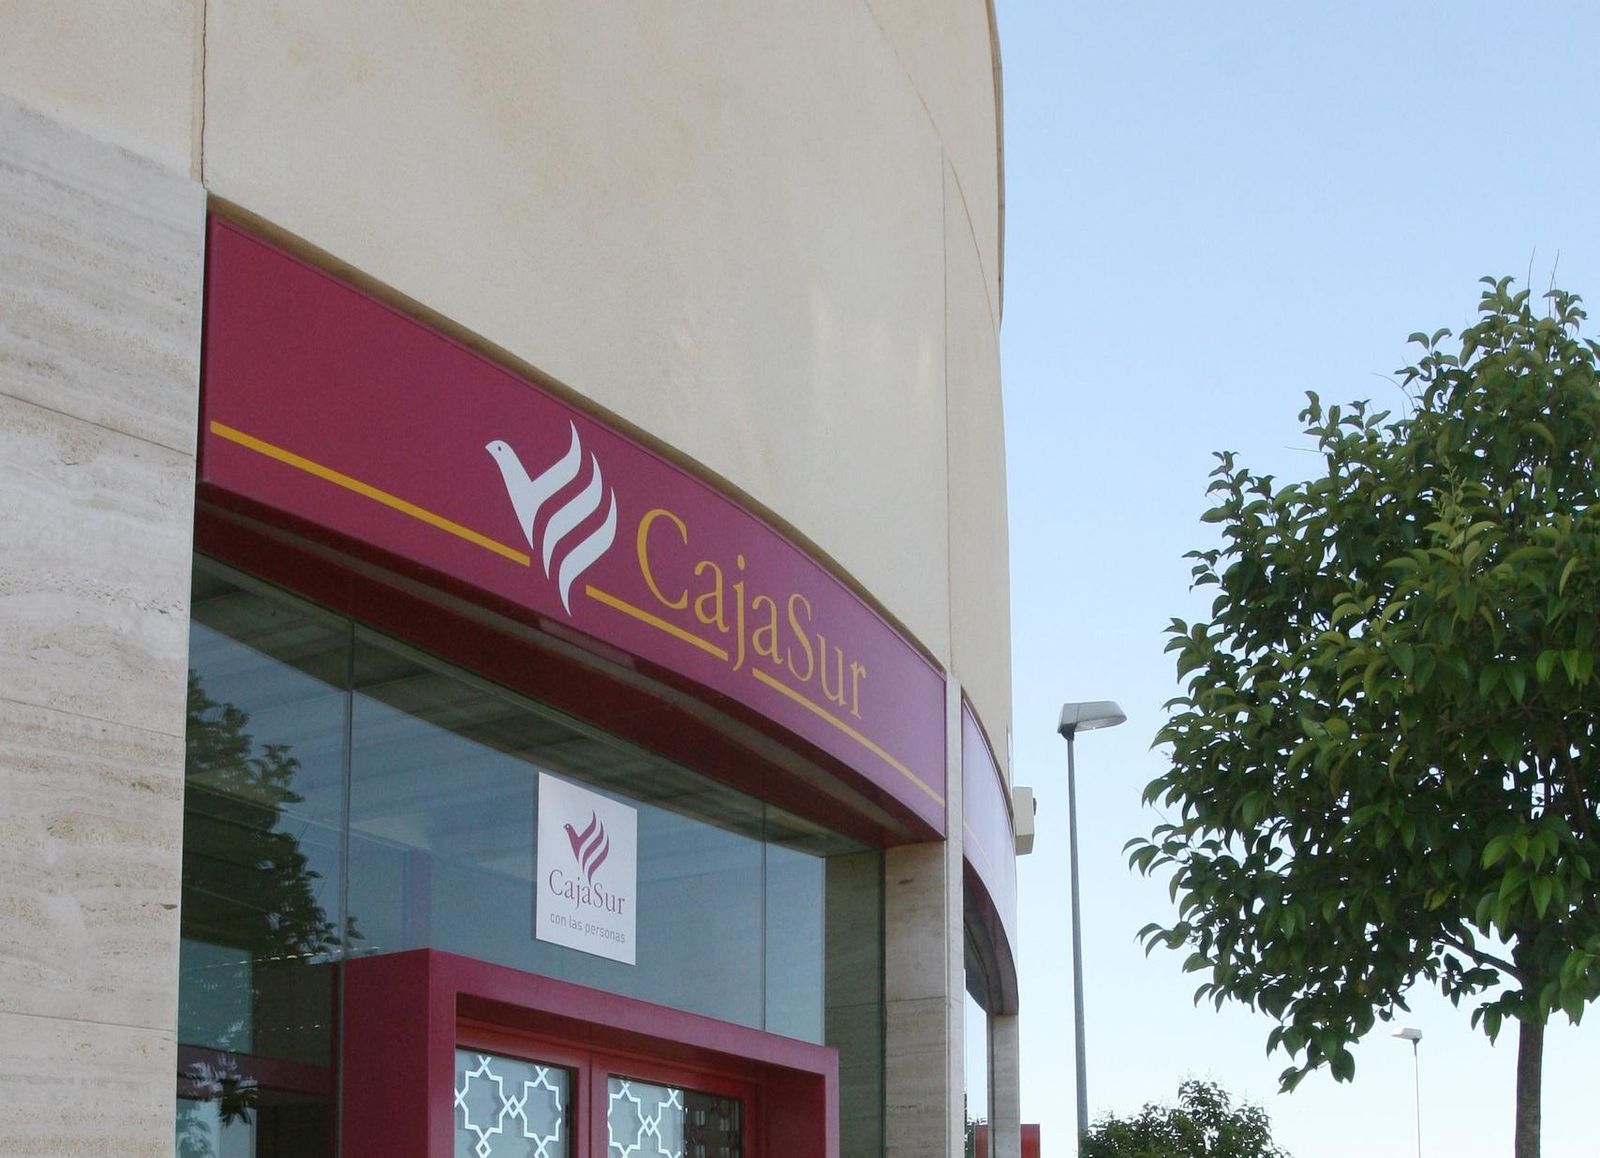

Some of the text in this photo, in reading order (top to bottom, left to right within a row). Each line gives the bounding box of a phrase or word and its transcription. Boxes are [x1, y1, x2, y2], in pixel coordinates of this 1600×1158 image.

[636, 508, 867, 720] CajaSur
[549, 868, 625, 915] CajaSur
[550, 913, 626, 944] con las personas
